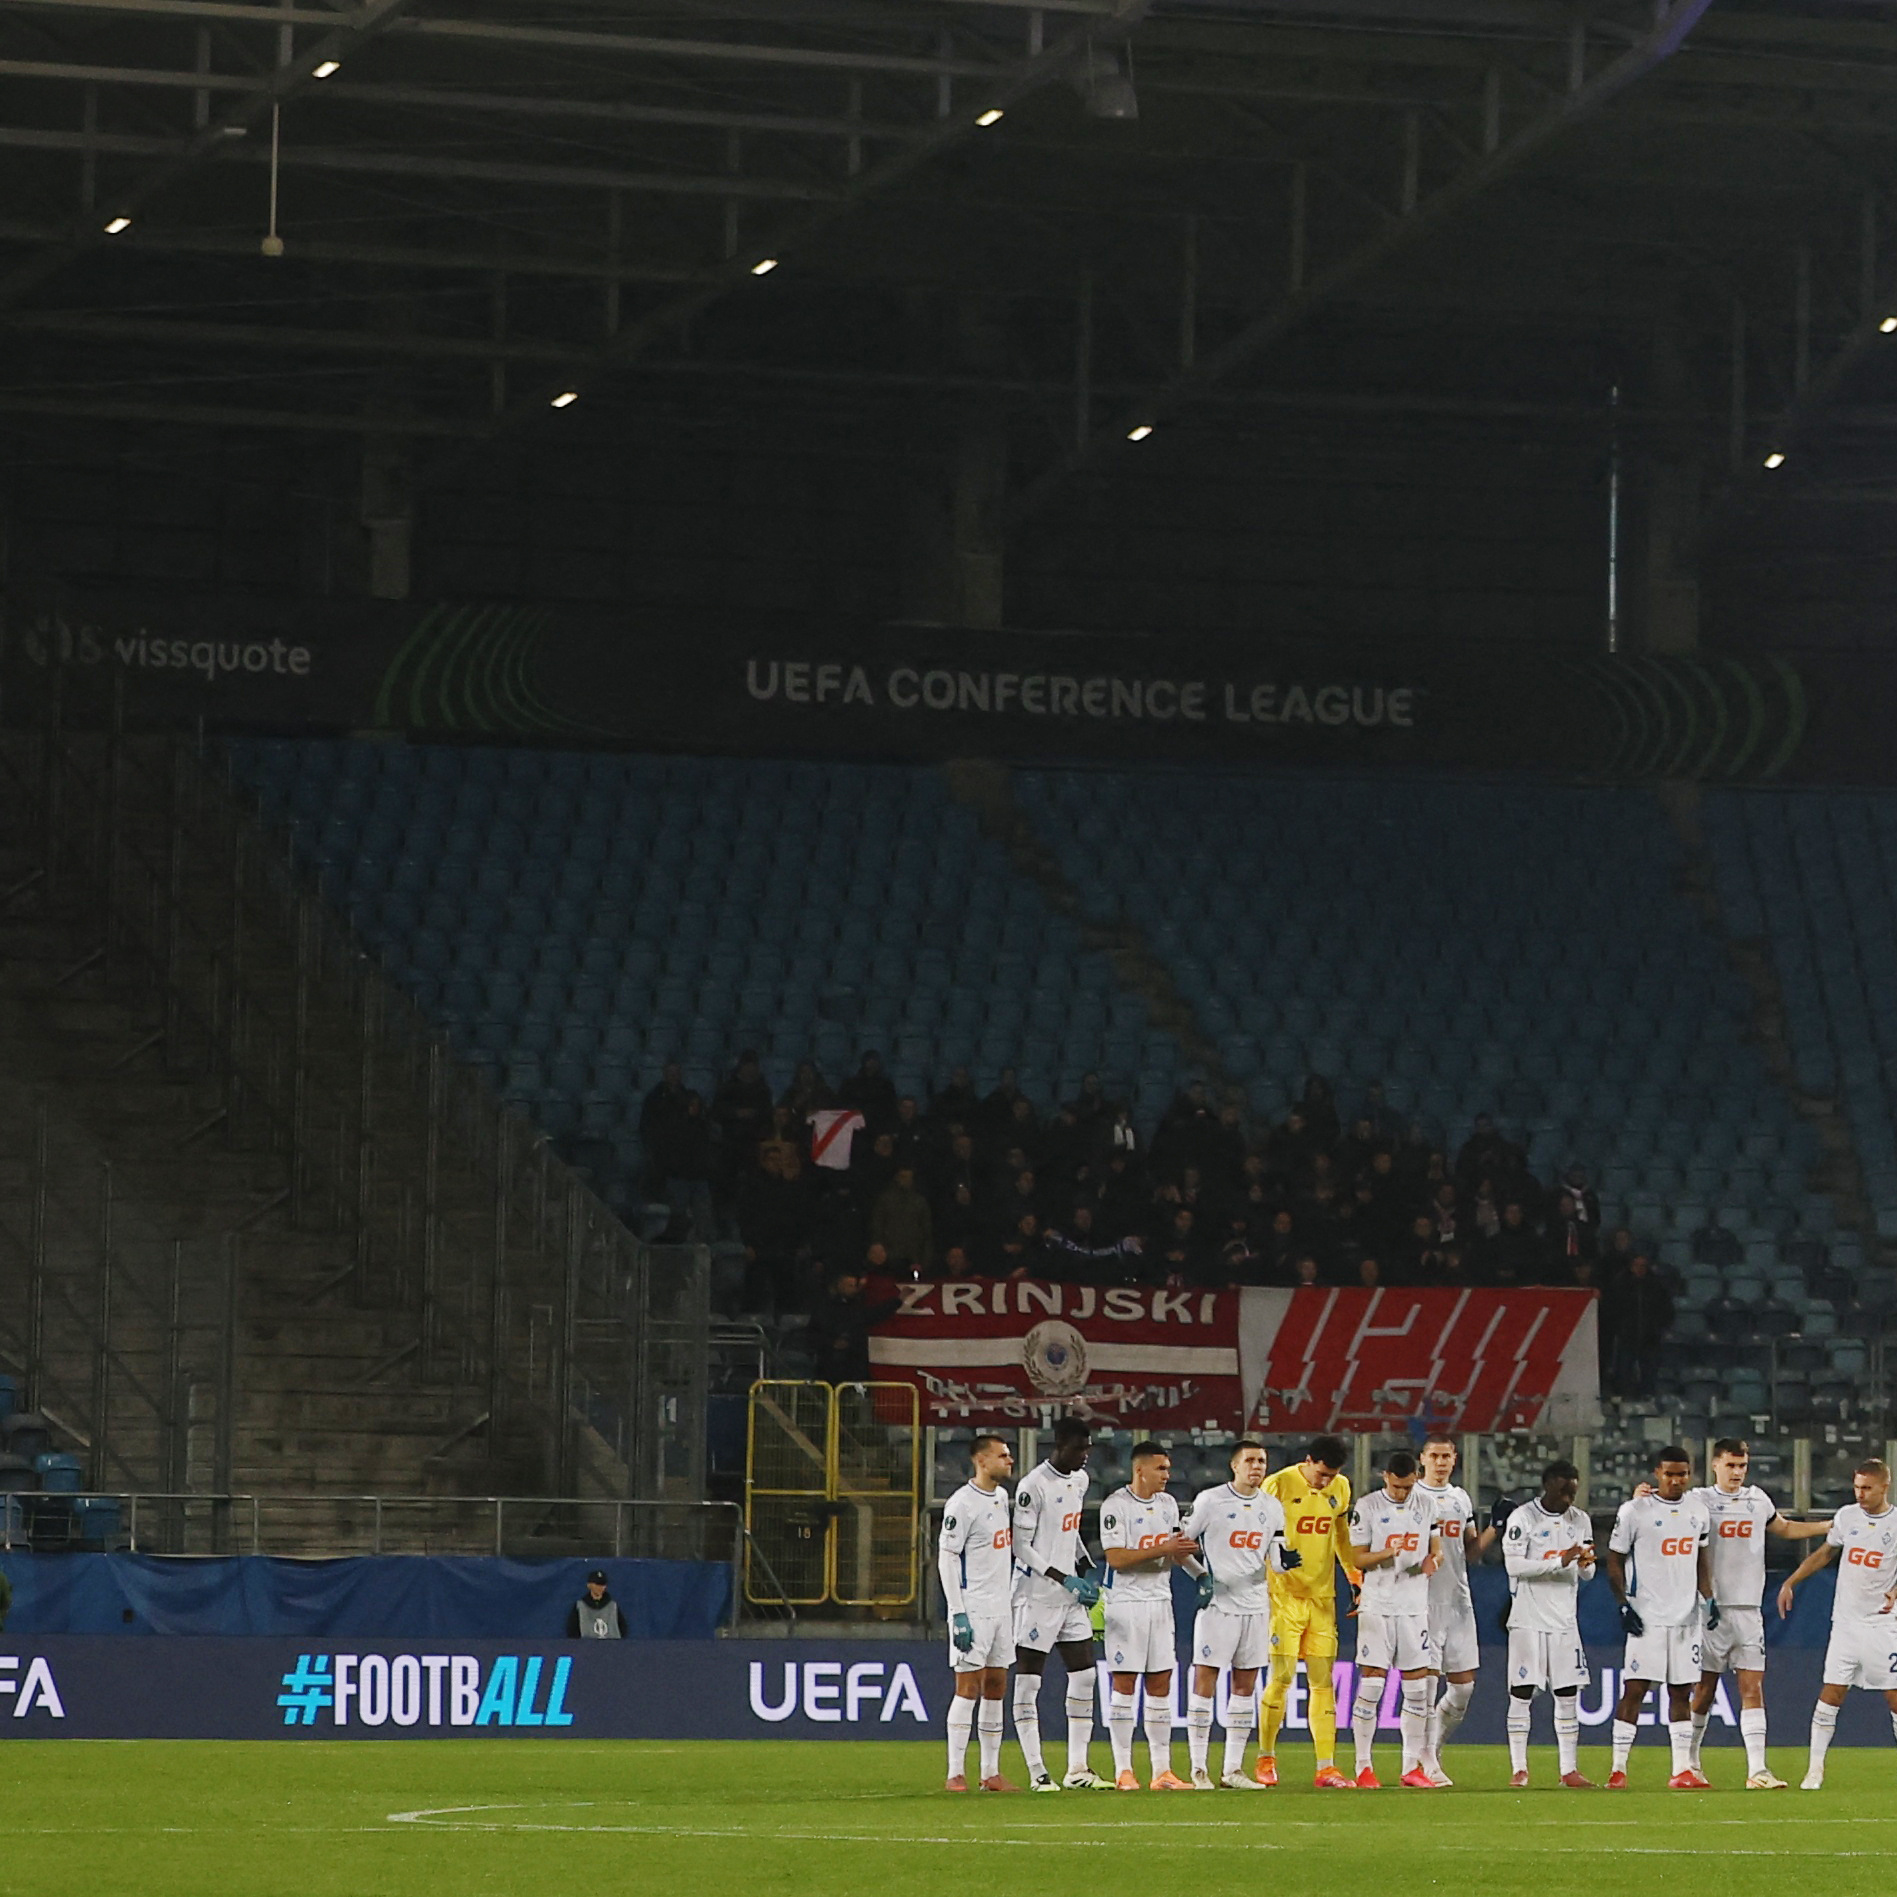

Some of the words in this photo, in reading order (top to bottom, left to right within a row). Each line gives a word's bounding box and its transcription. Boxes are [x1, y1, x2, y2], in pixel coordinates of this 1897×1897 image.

[746, 660, 874, 704] UEFA
[887, 668, 1207, 721] CONFERENCE
[1225, 683, 1414, 727] LEAGUE
[895, 1281, 1217, 1324] ZRINJSKI
[1296, 1516, 1332, 1534] GG
[1719, 1520, 1753, 1538] GG
[1229, 1530, 1264, 1550] GG
[1661, 1537, 1694, 1556] GG
[1848, 1547, 1884, 1569] GG
[277, 1654, 574, 1726] #FOOTBALL
[750, 1661, 929, 1722] UEFA
